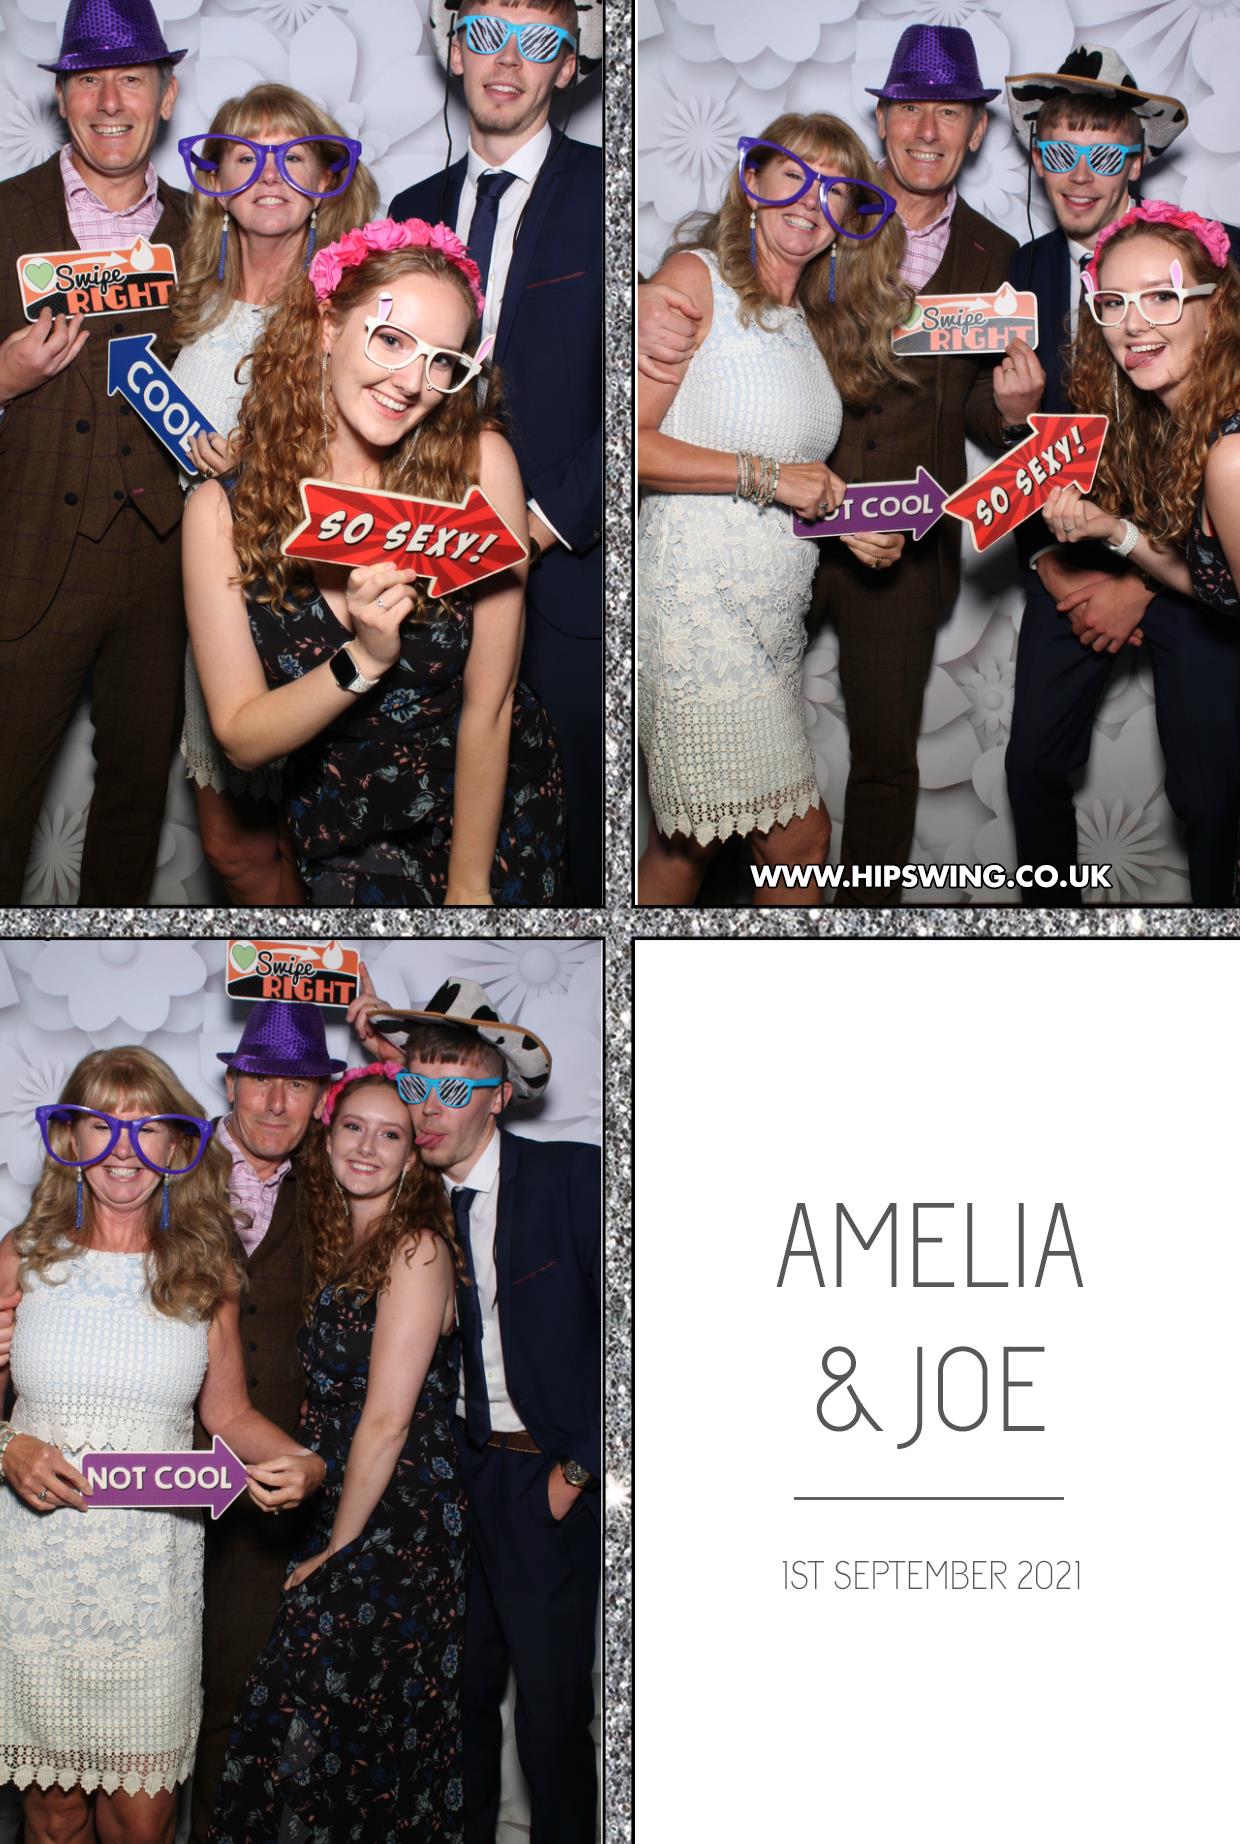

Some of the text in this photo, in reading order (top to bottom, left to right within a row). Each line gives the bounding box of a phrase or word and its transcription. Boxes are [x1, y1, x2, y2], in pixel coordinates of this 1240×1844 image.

[55, 264, 126, 295] Swipe
[66, 280, 174, 315] RIGHT
[922, 306, 987, 336] Swipe
[929, 325, 1034, 352] RIGHT
[127, 360, 201, 452] COOL
[976, 425, 1086, 527] SO SEXY!
[861, 493, 934, 519] COOL
[317, 509, 499, 564] SO SEXY!
[255, 950, 315, 986] Swipe
[262, 975, 356, 1005] RIGHT
[87, 1466, 233, 1490] NOT COOL
